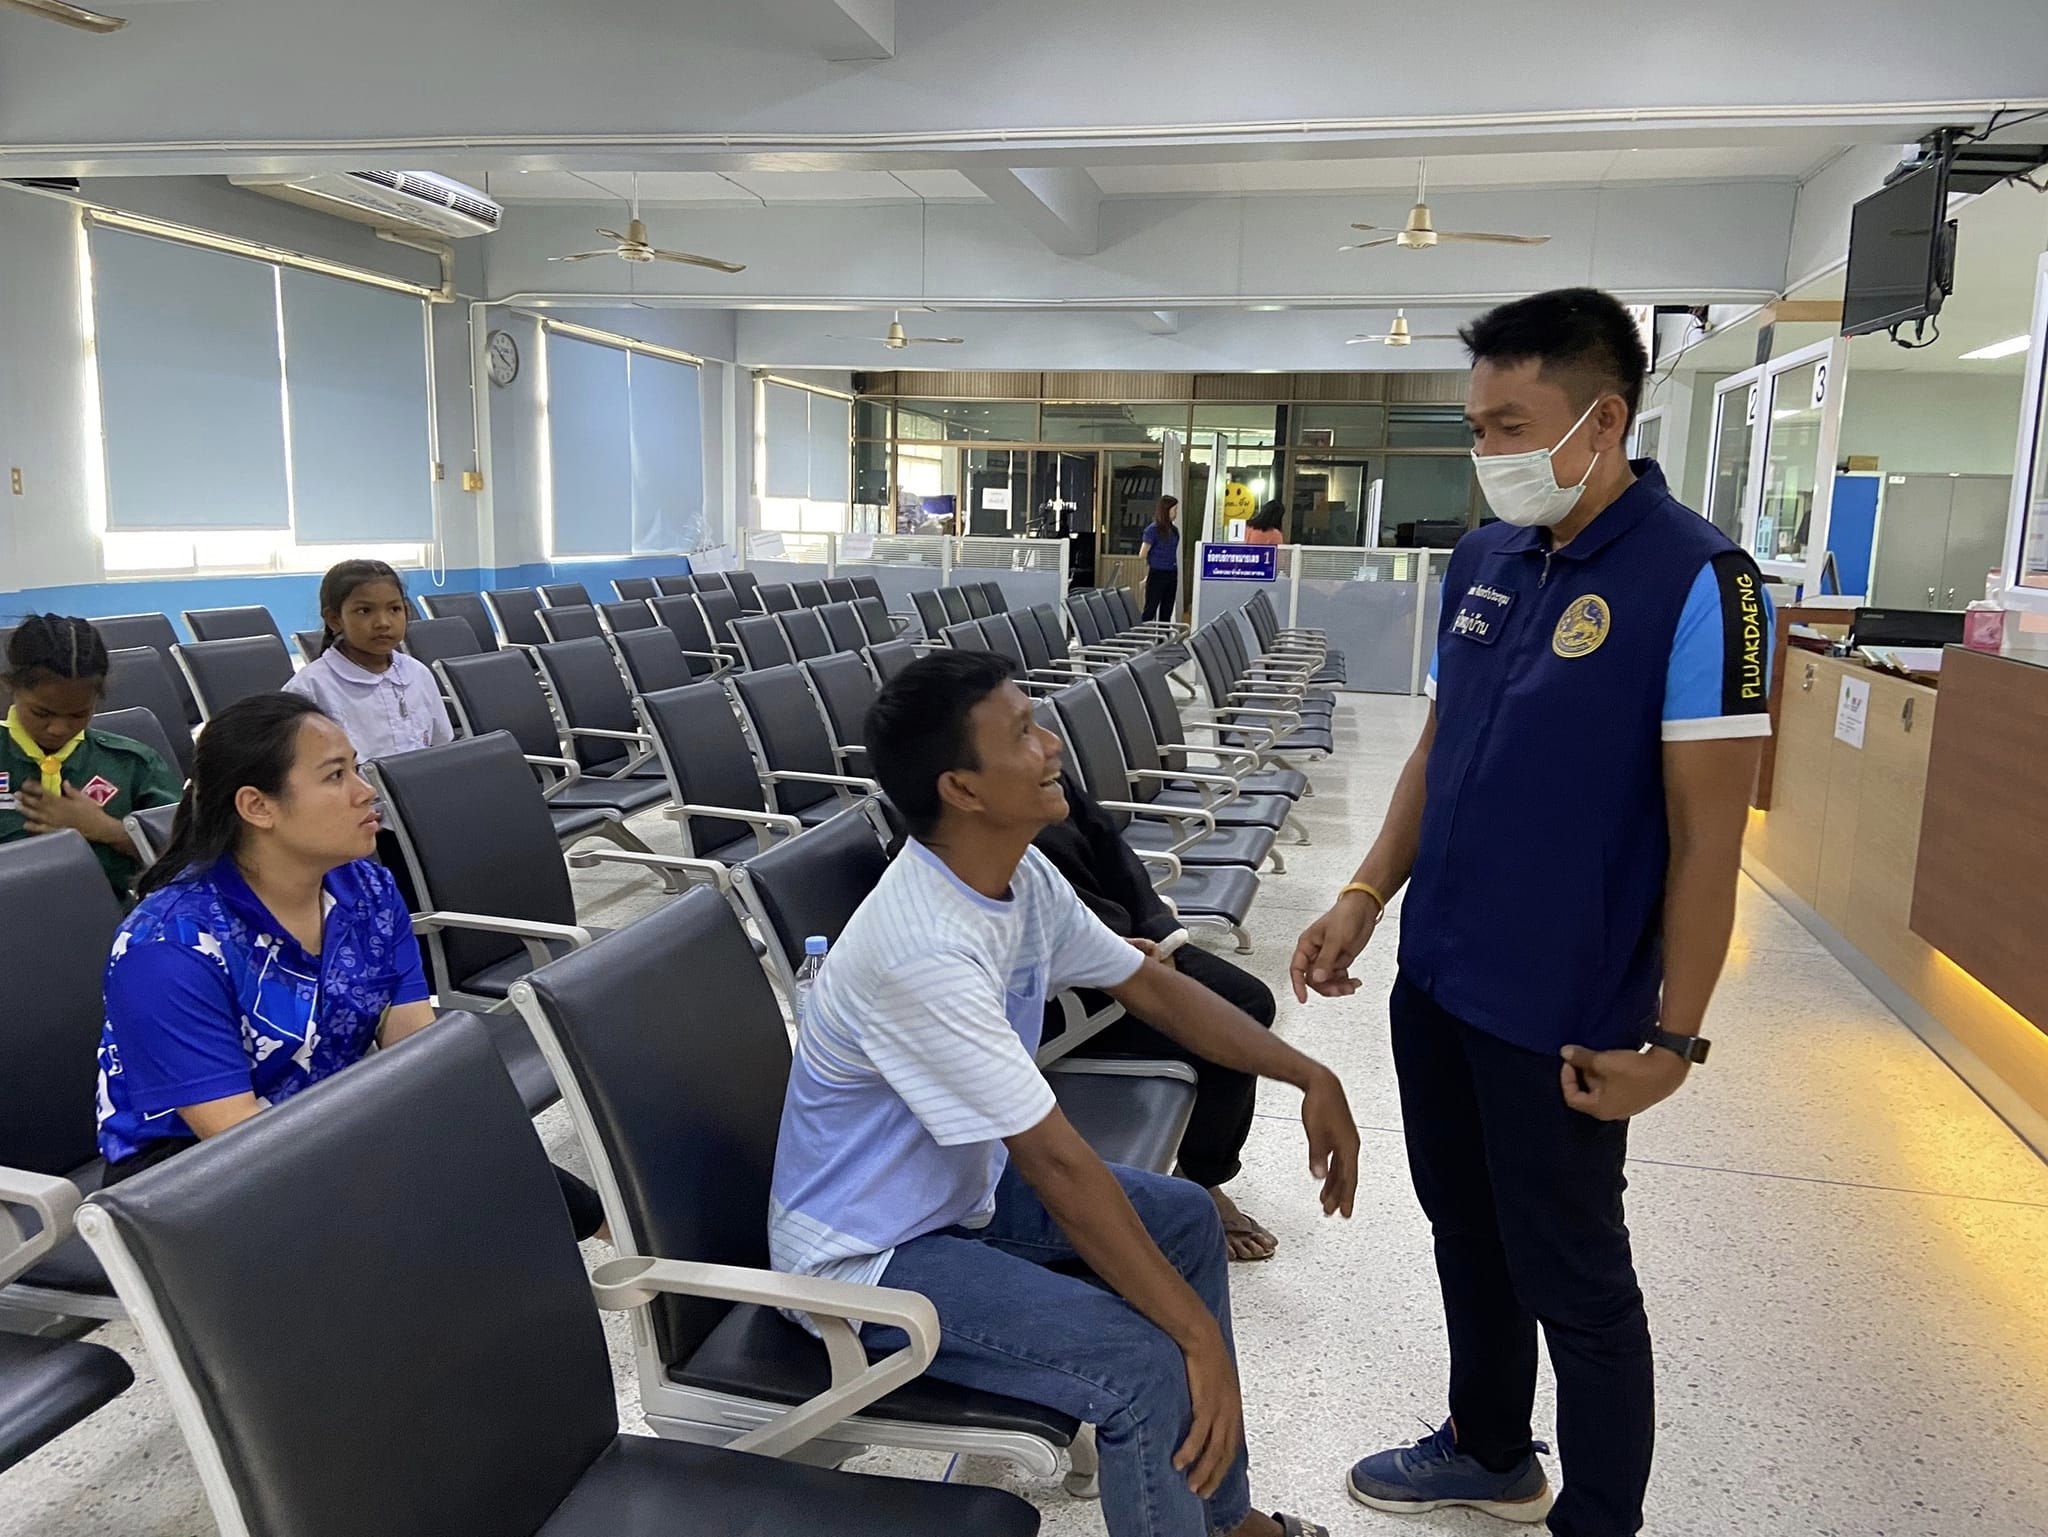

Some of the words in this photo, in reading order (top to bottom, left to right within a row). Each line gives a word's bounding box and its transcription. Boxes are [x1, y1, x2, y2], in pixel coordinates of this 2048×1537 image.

[1815, 365, 1826, 402] 3
[1749, 388, 1757, 419] 2
[1234, 523, 1239, 537] 1
[1264, 551, 1270, 564] 1
[1736, 573, 1761, 699] PLUAKDAENG
